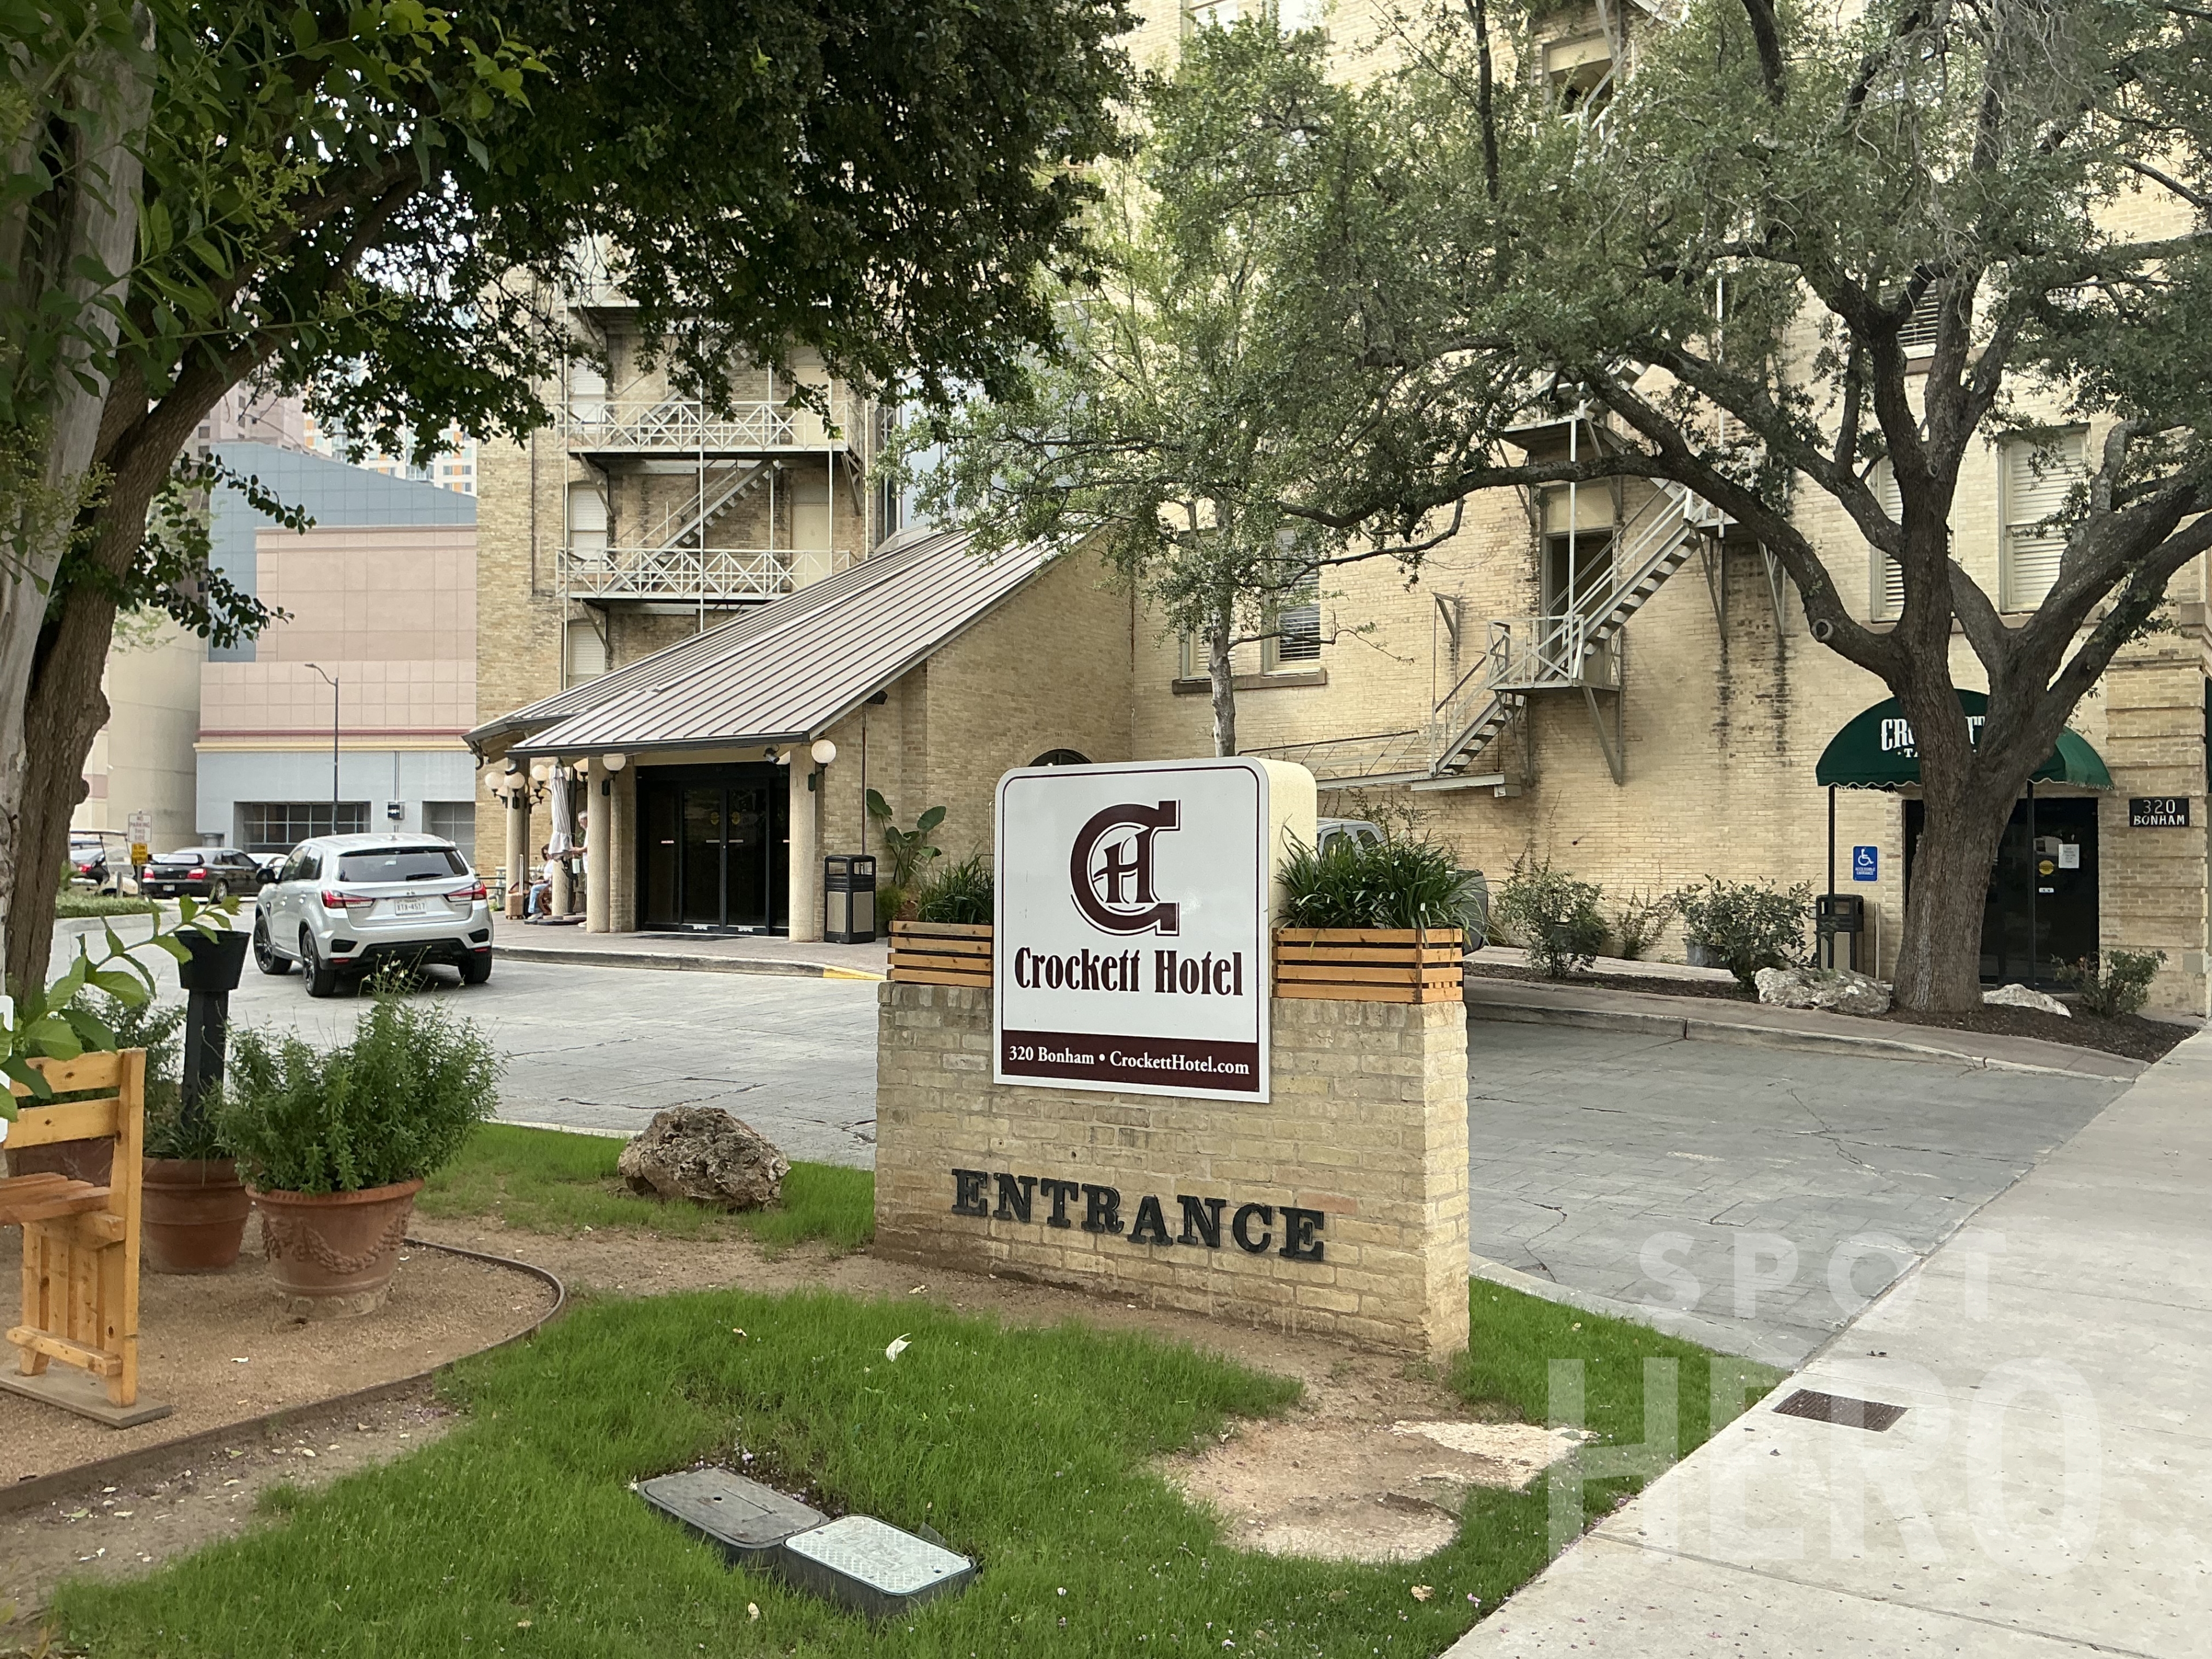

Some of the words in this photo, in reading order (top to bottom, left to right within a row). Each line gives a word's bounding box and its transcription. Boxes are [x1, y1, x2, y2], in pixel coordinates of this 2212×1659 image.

[2133, 815, 2185, 825] BONHAM
[2143, 799, 2176, 814] 320
[1014, 946, 1141, 992] Crockett
[1154, 950, 1243, 996] Hotel
[1009, 1046, 1034, 1061] 320
[1037, 1046, 1094, 1065] Bonham
[1109, 1050, 1250, 1074] CrockettHotel.com
[951, 1168, 1324, 1263] ENTRANCE
